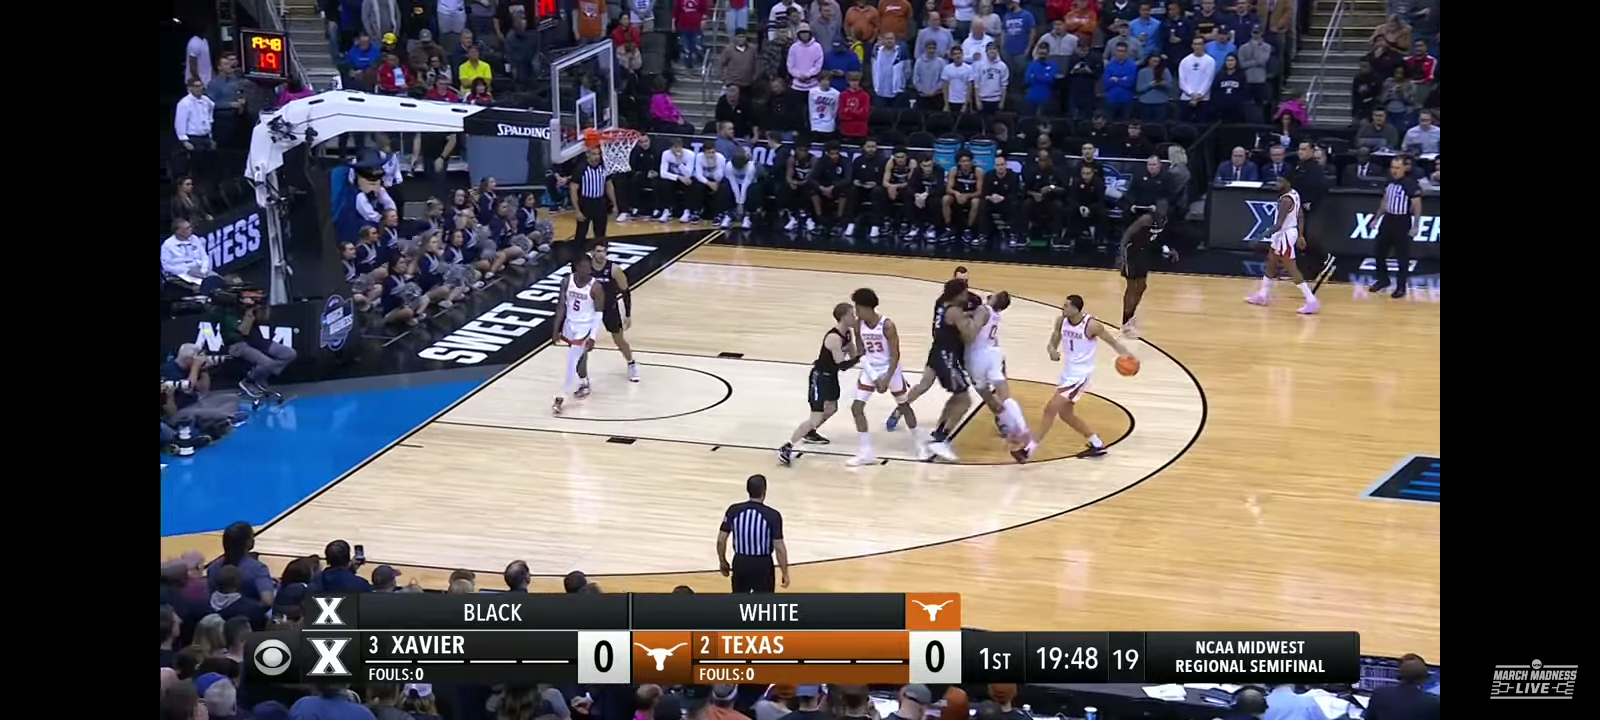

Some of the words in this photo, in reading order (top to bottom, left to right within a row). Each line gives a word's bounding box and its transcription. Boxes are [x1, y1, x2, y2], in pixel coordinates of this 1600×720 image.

[260, 53, 276, 69] 19
[497, 123, 550, 140] SPALDING
[200, 213, 260, 273] NESS
[573, 299, 581, 311] 5
[418, 303, 556, 365] SWEET
[866, 342, 884, 353] 23
[1070, 340, 1075, 351] 1
